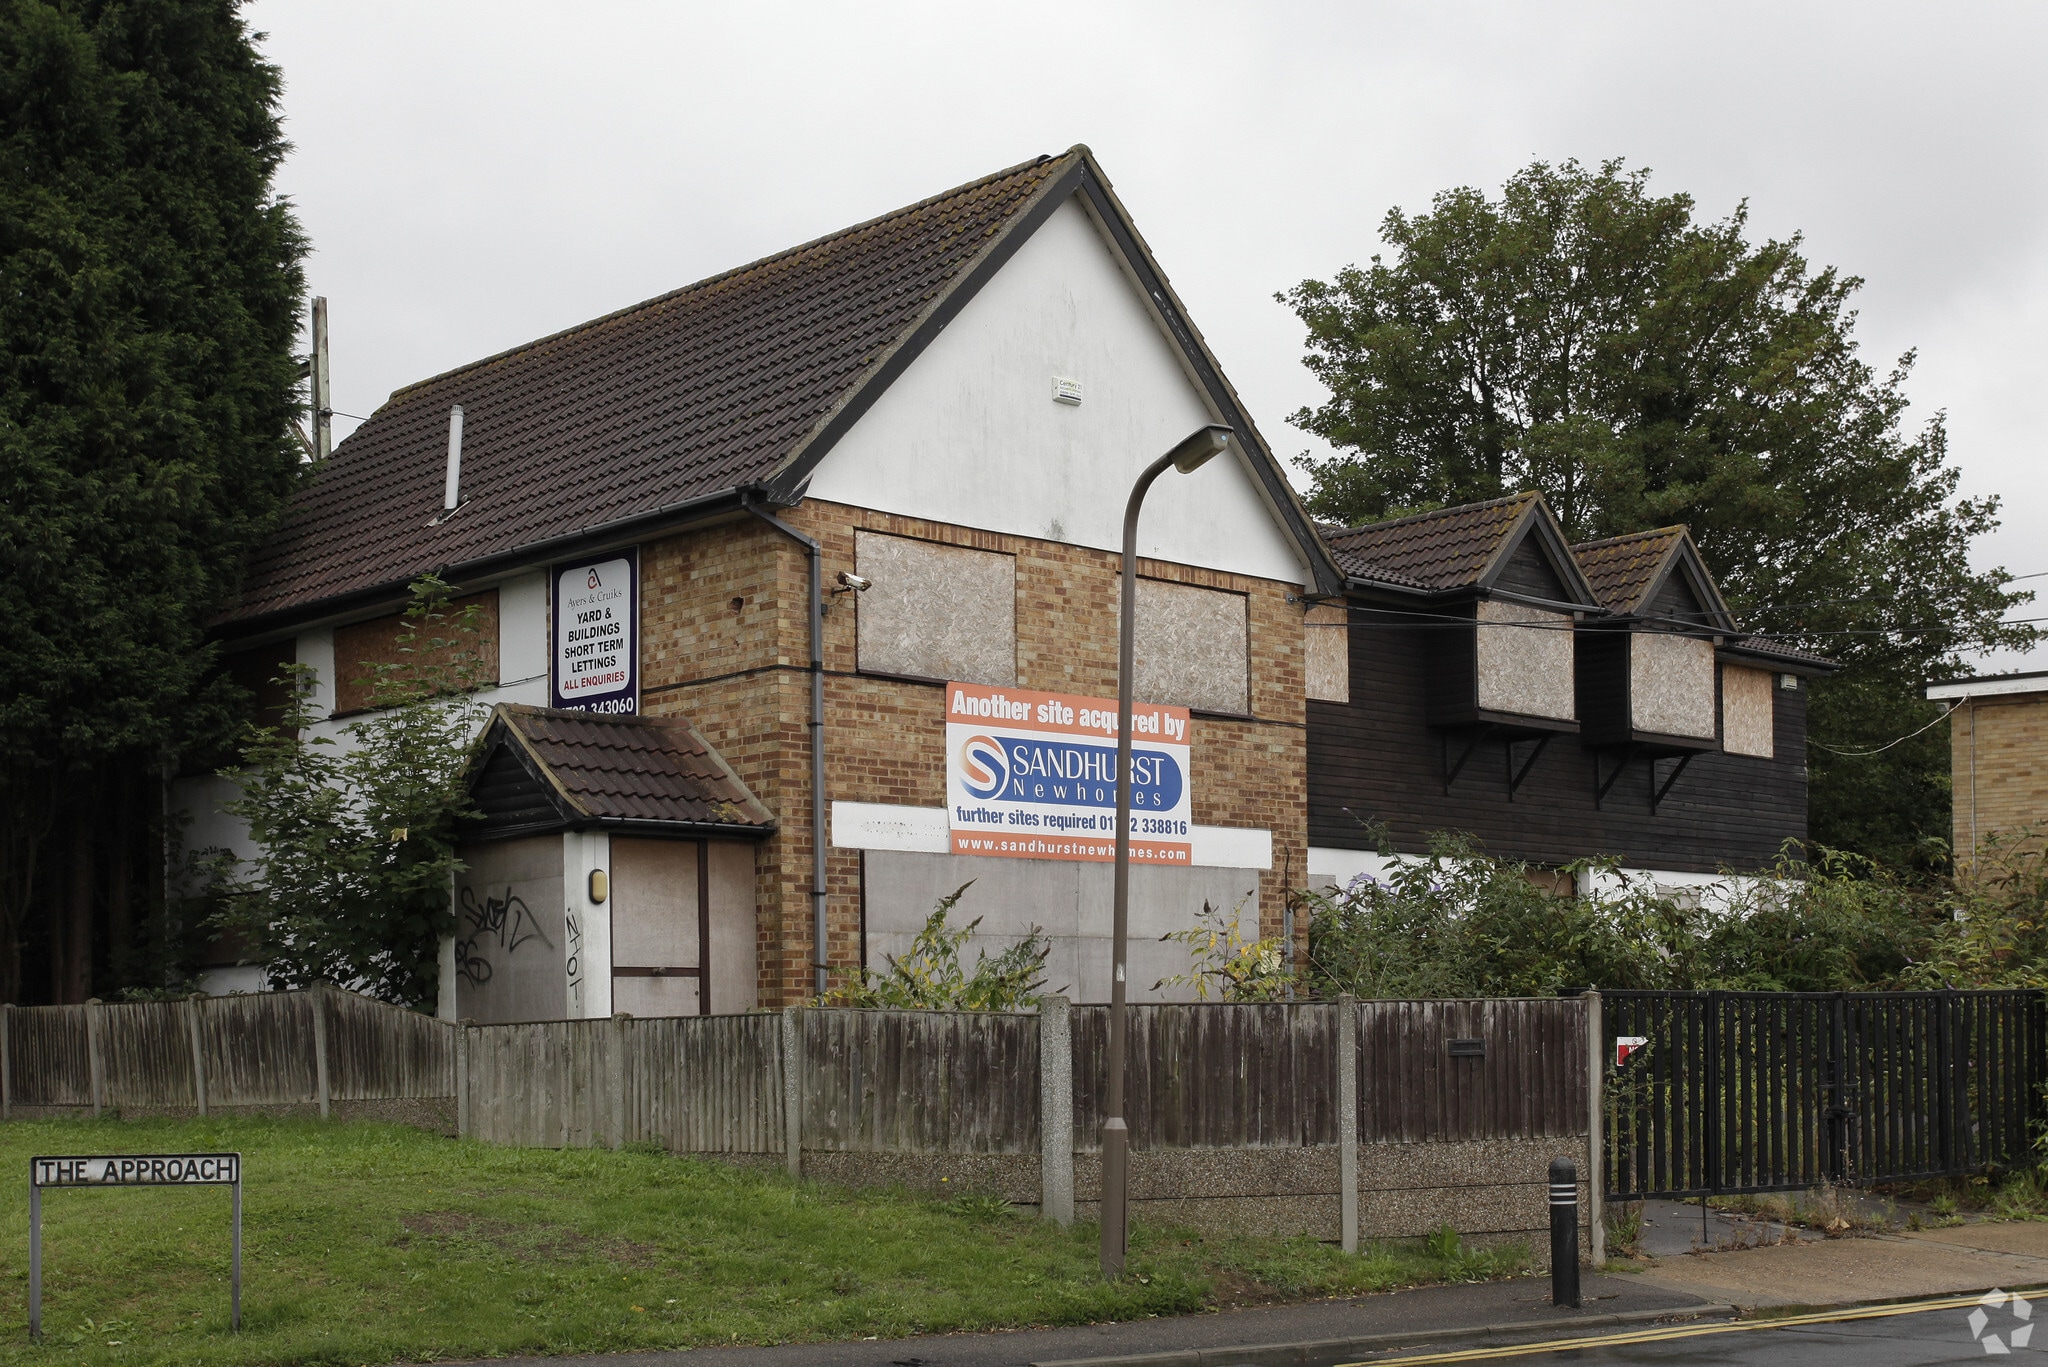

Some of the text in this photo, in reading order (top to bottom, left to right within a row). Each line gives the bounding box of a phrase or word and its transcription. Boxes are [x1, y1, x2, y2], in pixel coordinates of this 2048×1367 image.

[567, 588, 622, 611] Ayers & Cruiks
[577, 607, 612, 625] YARD &
[568, 622, 620, 643] BUILDINGS
[564, 638, 624, 659] SHORT TERM
[572, 655, 617, 673] LETTINGS
[564, 671, 625, 691] ALL ENQUIRIES
[591, 697, 634, 714] 343060
[951, 690, 1185, 741] Another site acqured by
[1013, 778, 1162, 806] Newhoes
[956, 806, 1187, 836] further sites required 012 338816
[958, 837, 1187, 860] www.sandhurstnewhmes.com
[39, 1157, 234, 1183] THE APPROACH
